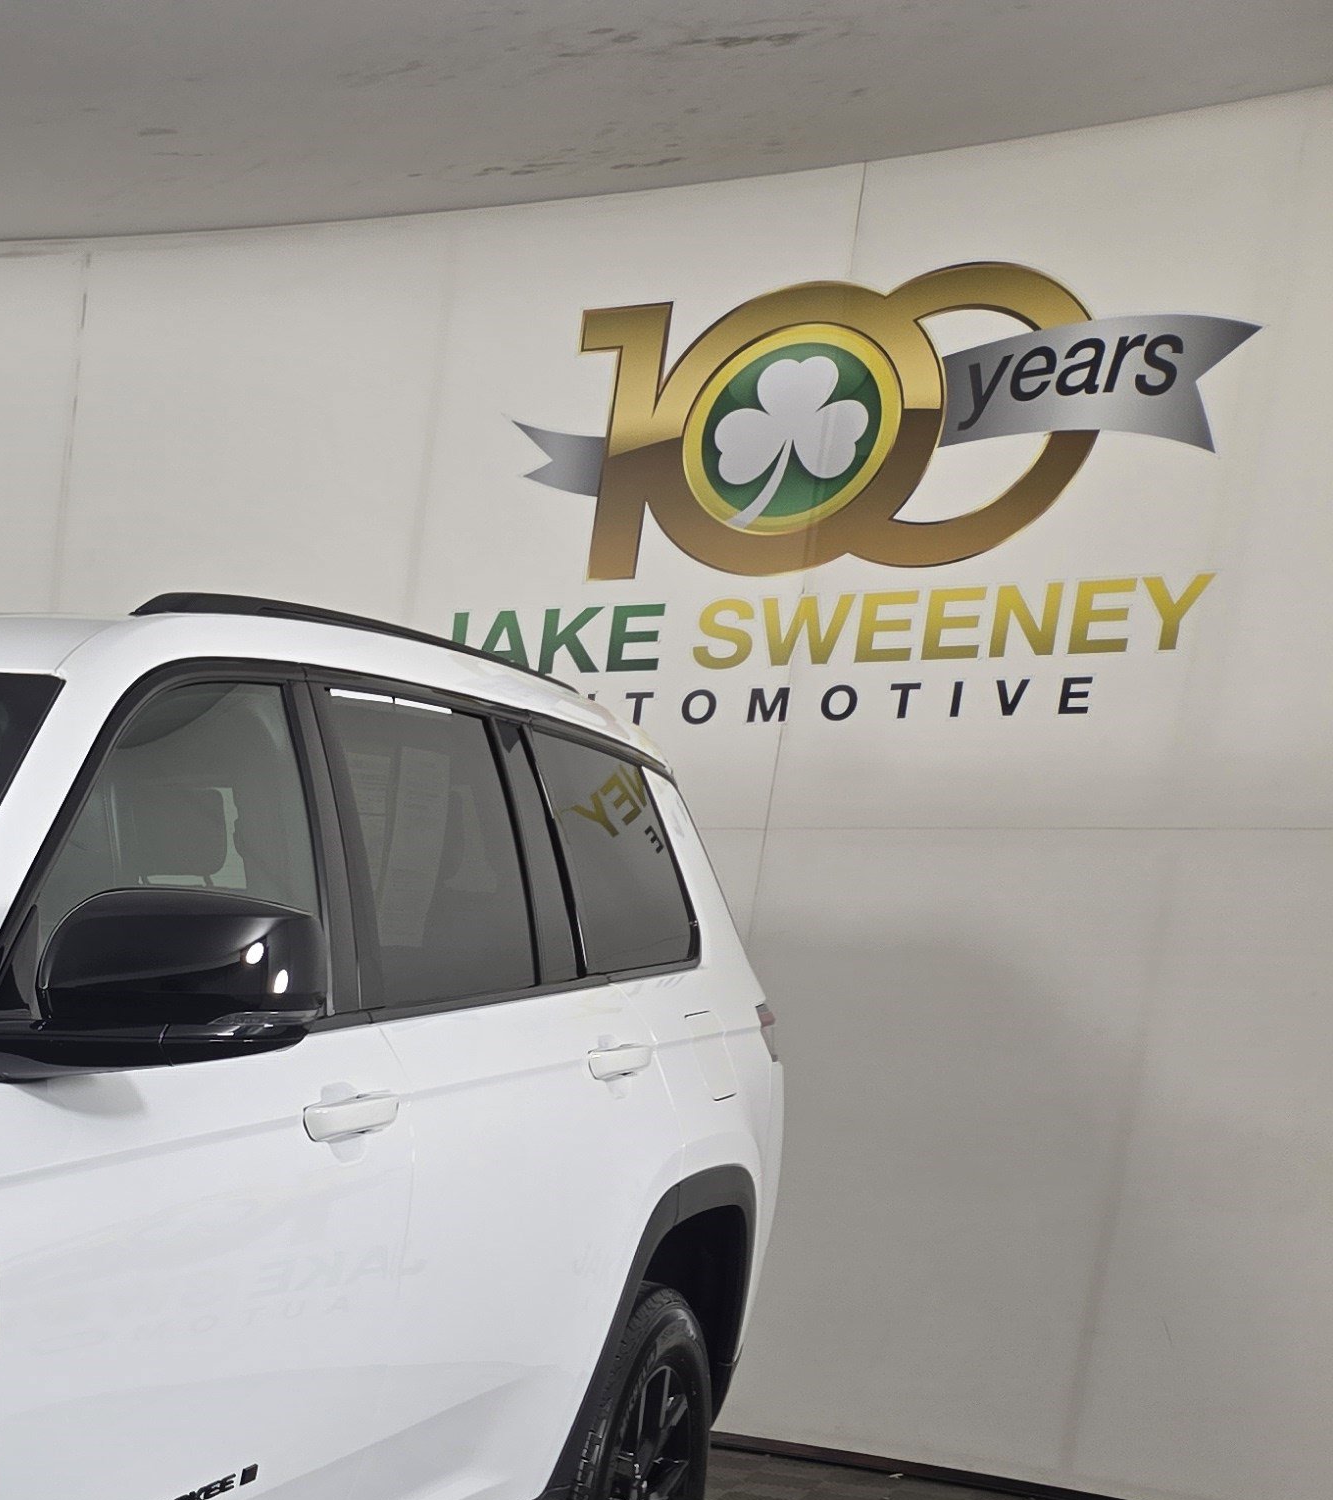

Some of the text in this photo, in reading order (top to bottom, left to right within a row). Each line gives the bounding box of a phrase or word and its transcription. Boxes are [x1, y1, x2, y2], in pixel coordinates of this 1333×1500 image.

[577, 261, 1185, 583] 100 years
[692, 571, 1215, 671] SWEENEY
[588, 676, 1095, 727] TOMOTIVE
